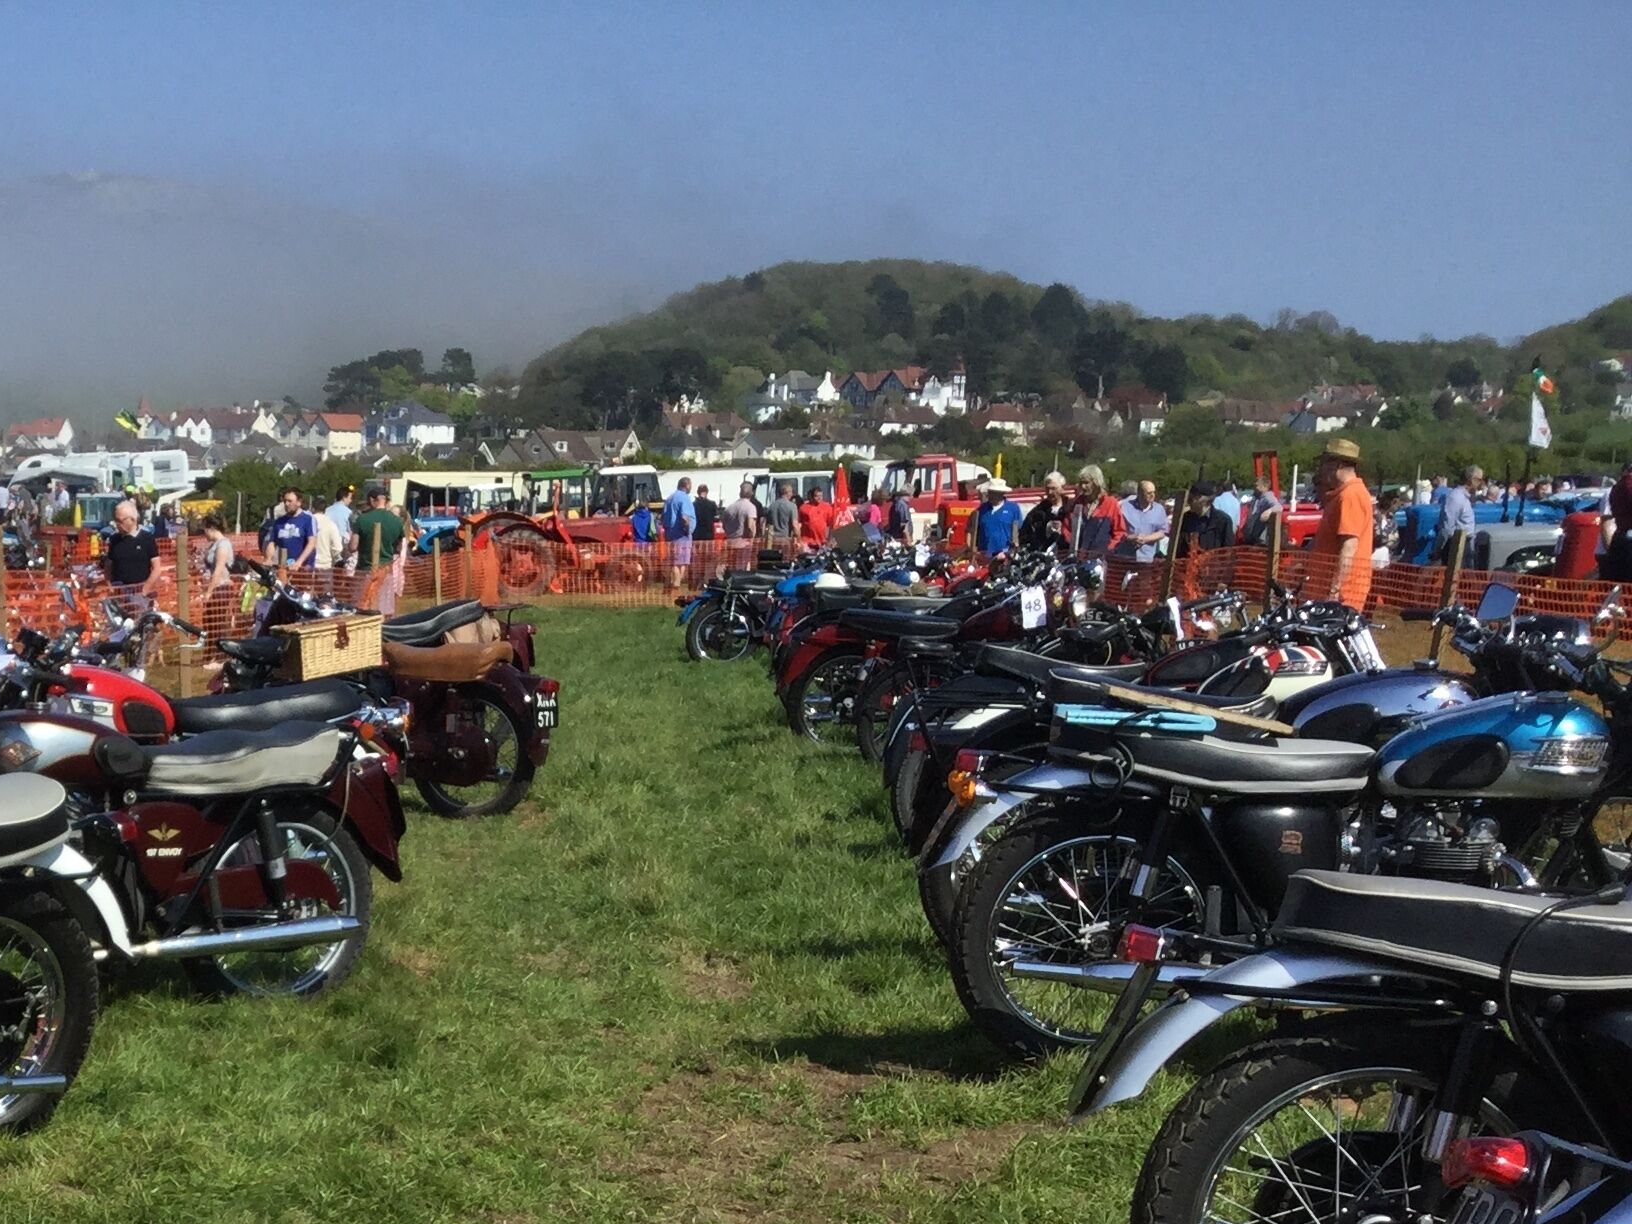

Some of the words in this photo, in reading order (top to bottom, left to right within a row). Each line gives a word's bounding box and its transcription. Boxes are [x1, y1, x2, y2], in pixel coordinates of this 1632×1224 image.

[1024, 598, 1042, 613] 48
[537, 711, 555, 728] 571
[158, 847, 183, 857] ENVOY
